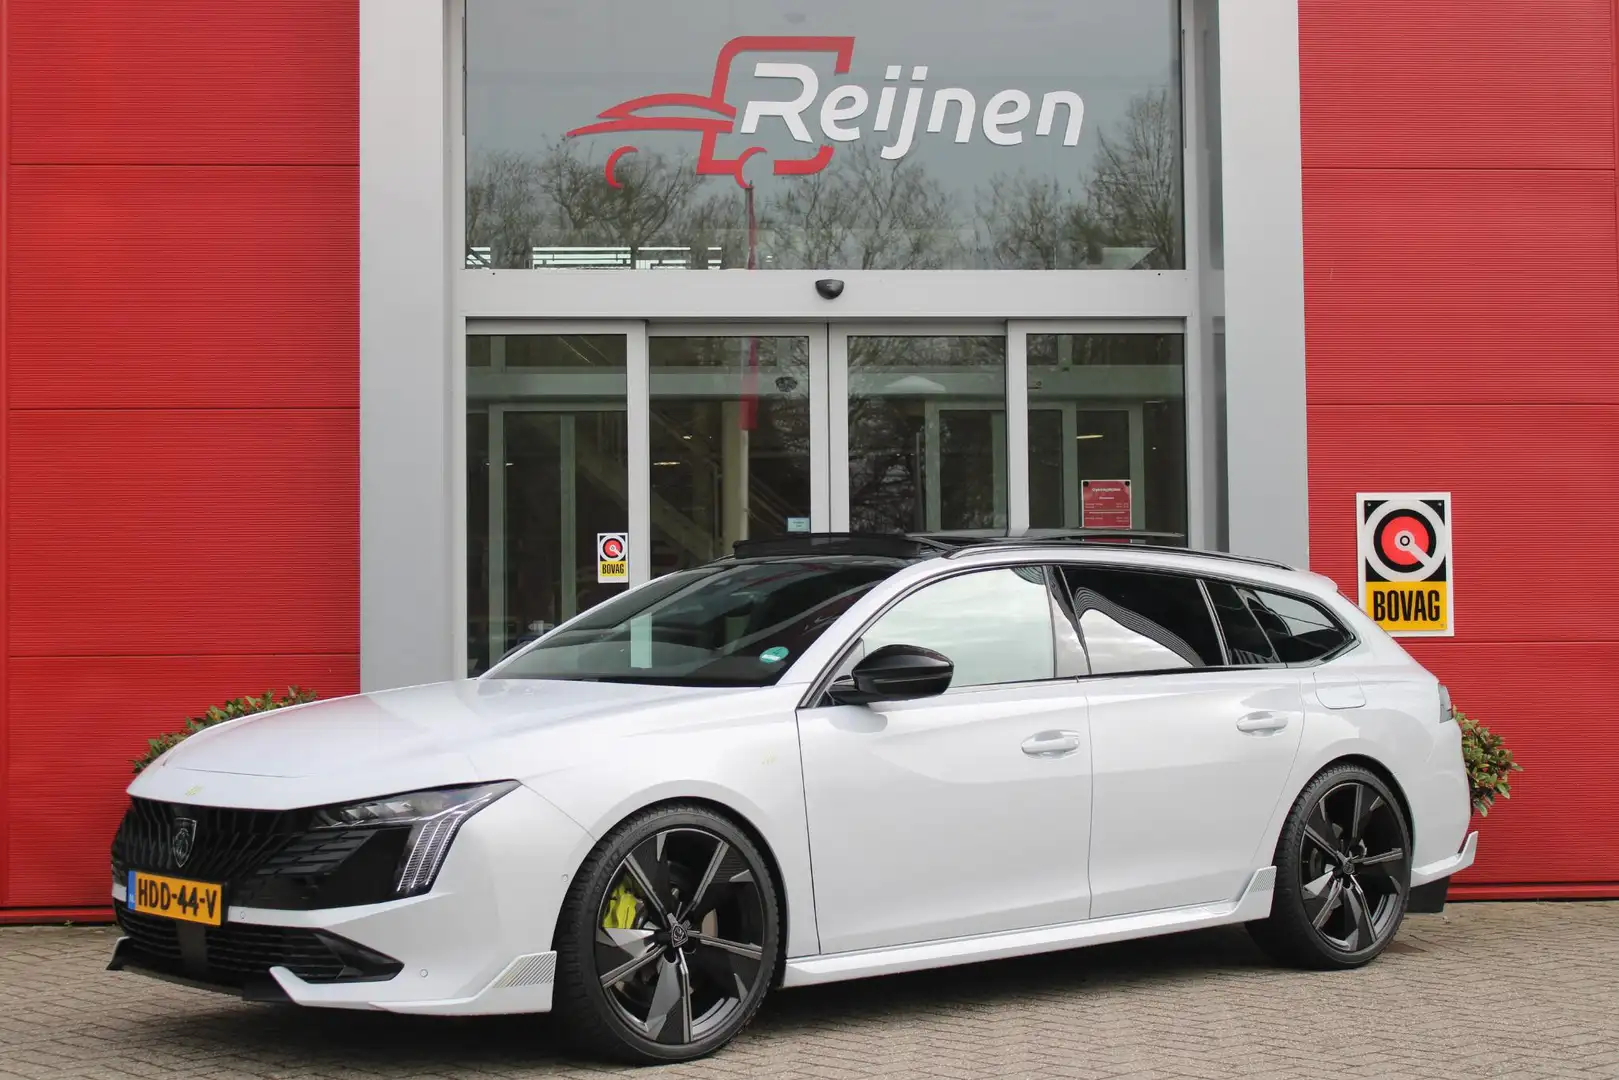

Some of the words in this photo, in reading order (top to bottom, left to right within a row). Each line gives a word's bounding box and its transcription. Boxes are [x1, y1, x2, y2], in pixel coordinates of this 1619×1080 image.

[740, 62, 1085, 160] Reijnen
[602, 563, 625, 575] BOVAG
[1373, 590, 1440, 622] BOVAG
[138, 878, 217, 919] HDD-44-V
